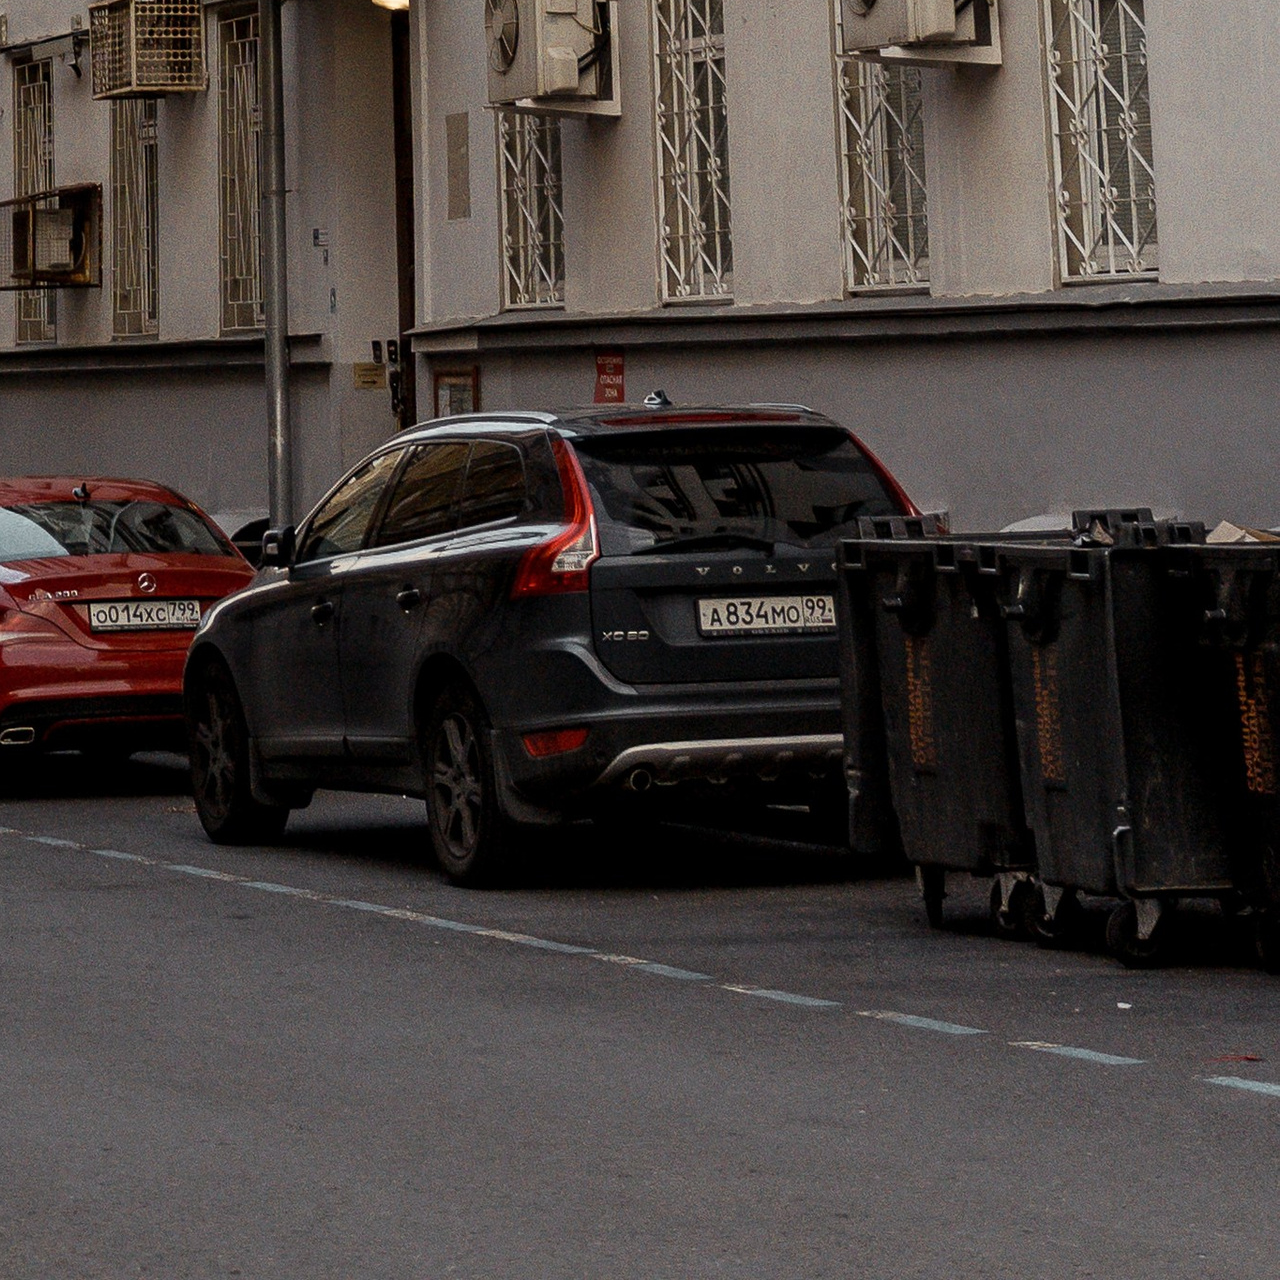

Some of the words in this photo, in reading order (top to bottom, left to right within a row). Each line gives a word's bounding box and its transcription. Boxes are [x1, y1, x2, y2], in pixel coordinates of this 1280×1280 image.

[171, 601, 196, 616] 799
[710, 600, 800, 627] А834МО
[805, 598, 827, 617] 99
